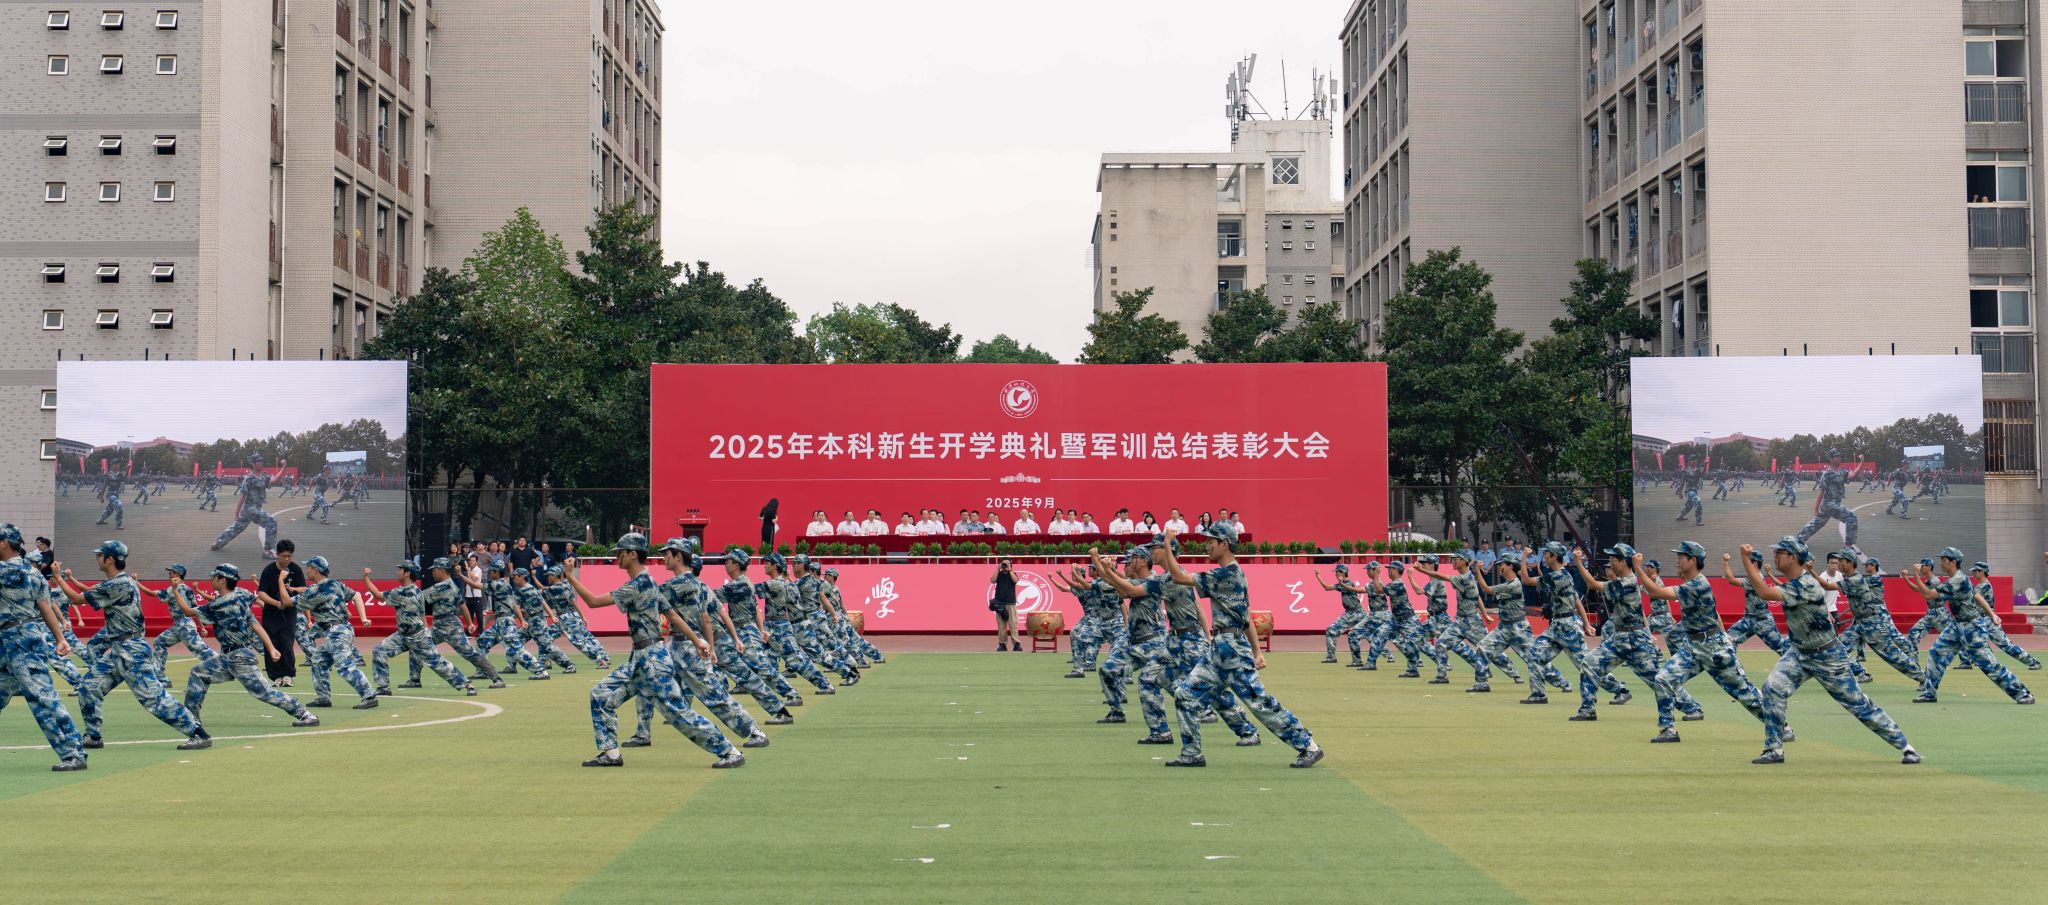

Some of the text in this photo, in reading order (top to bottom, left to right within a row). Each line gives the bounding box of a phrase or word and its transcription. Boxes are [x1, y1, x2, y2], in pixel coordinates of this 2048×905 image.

[709, 431, 1330, 460] 2025年本科新生开学典礼暨军训总结表彰大会
[986, 496, 1055, 510] 2025年9月
